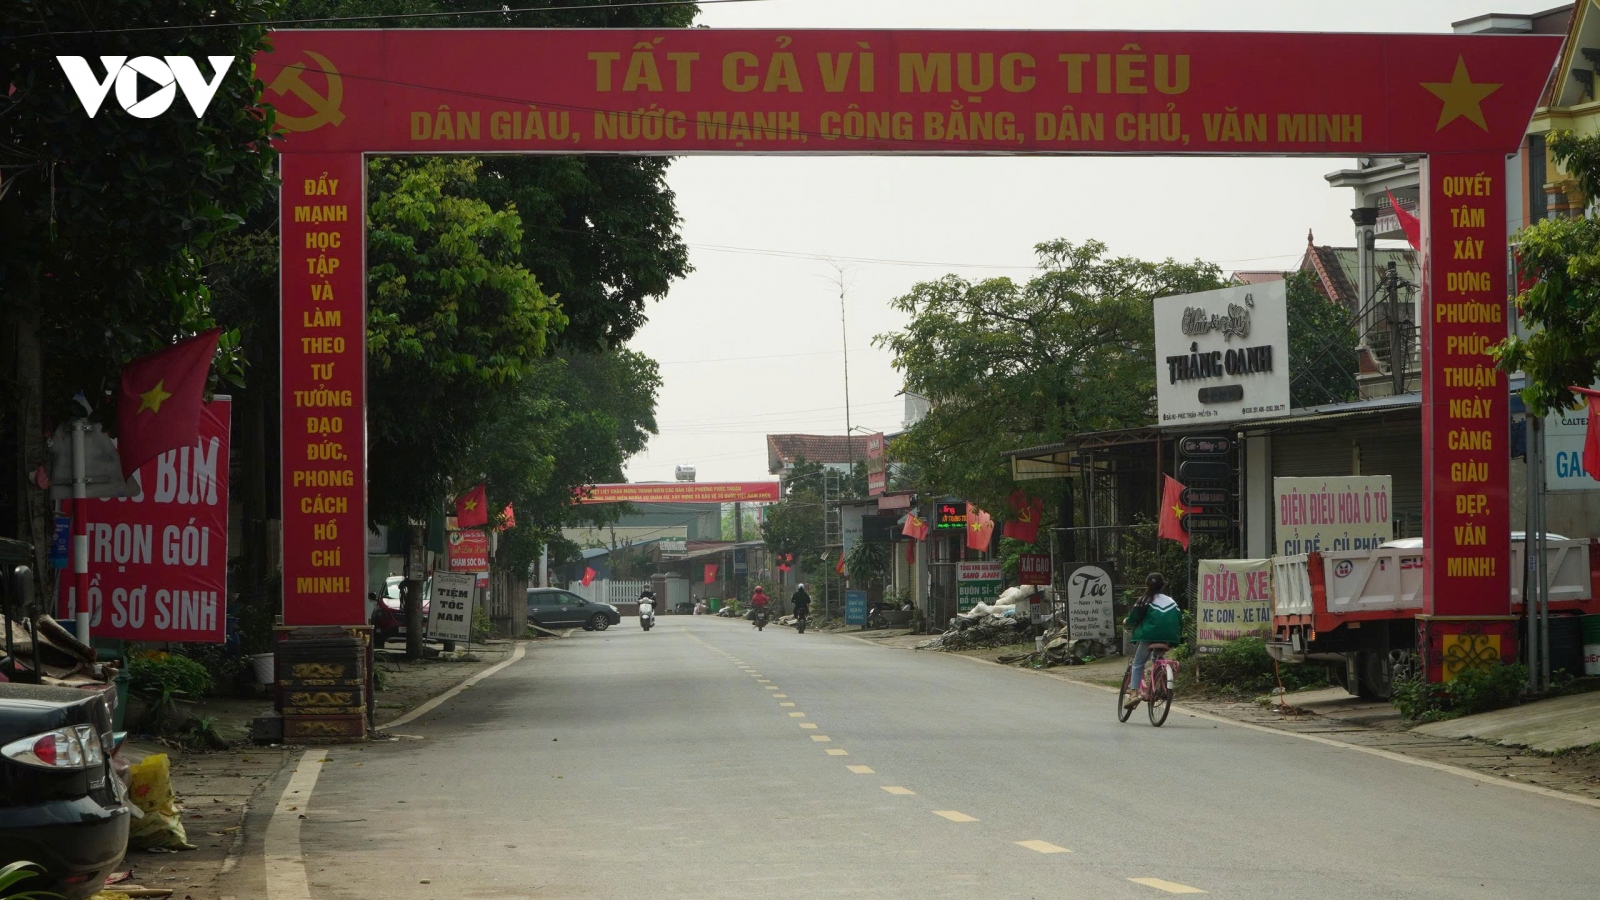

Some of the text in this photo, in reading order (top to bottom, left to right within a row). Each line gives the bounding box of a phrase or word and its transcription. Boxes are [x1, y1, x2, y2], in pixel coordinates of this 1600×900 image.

[588, 36, 1190, 103] TẤT CẢ VÌ MỤC TIÊU
[411, 100, 1362, 147] DÂN GIÀU, NƯỚC MẠNH, CÔNG BẰNG, DÂN CHỦ, VĂN MINH
[305, 172, 338, 196] ĐẨY
[1443, 172, 1491, 197] QUYẾT
[295, 205, 347, 224] MẠNH
[1451, 205, 1485, 228] TÂM
[306, 232, 341, 252] HỌC
[1453, 236, 1484, 260] XÂY
[307, 254, 340, 277] TẬP
[311, 281, 334, 300] VÀ
[1448, 270, 1491, 295] DỰNG
[304, 308, 341, 327] LÀM
[1437, 299, 1501, 323] PHƯỜNG
[302, 337, 345, 354] THEO
[1448, 333, 1490, 355] PHÚC
[311, 362, 335, 380] TƯ
[1224, 345, 1273, 376] OANH
[1444, 364, 1497, 390] THUẬN
[294, 384, 352, 407] TƯỞNG
[1449, 396, 1492, 419] NGÀY
[307, 417, 342, 437] ĐẠO
[1448, 427, 1492, 450] CÀNG
[307, 439, 347, 461] ĐỨC,
[154, 436, 219, 506] BIM
[1451, 459, 1488, 482] GIÀU
[1557, 451, 1593, 478] GA
[294, 470, 353, 486] PHONG
[301, 494, 347, 514] CÁCH
[1281, 486, 1306, 533] ĐIỆN
[1338, 485, 1360, 523] HÒA
[1364, 485, 1371, 523] Ô
[1374, 485, 1388, 523] TÔ
[1456, 494, 1490, 517] ĐẸP,
[314, 518, 337, 540] HỒ
[1454, 523, 1486, 546] VĂN
[162, 517, 209, 567] GÓI
[1285, 533, 1301, 557] CỦ
[1305, 533, 1321, 552] ĐỀ
[1333, 532, 1350, 551] CỦ
[1354, 533, 1386, 550] PHÁT
[311, 547, 341, 567] CHÍ
[1021, 554, 1049, 574] XÁT GẠO
[1447, 558, 1495, 577] MINH!
[297, 577, 350, 594] MINH!
[981, 571, 999, 579] ANH
[1072, 572, 1107, 599] Tóc
[1202, 563, 1269, 603] RỬA XE
[437, 588, 468, 599] TIỆM
[959, 585, 979, 595] BUÔN
[111, 584, 147, 628] SƠ
[154, 588, 217, 631] SINH
[440, 600, 464, 610] TÓC
[1203, 608, 1213, 623] XE
[1217, 608, 1234, 623] CON
[1243, 608, 1253, 622] XE
[1256, 603, 1270, 622] TẢI
[437, 613, 464, 622] NAM
